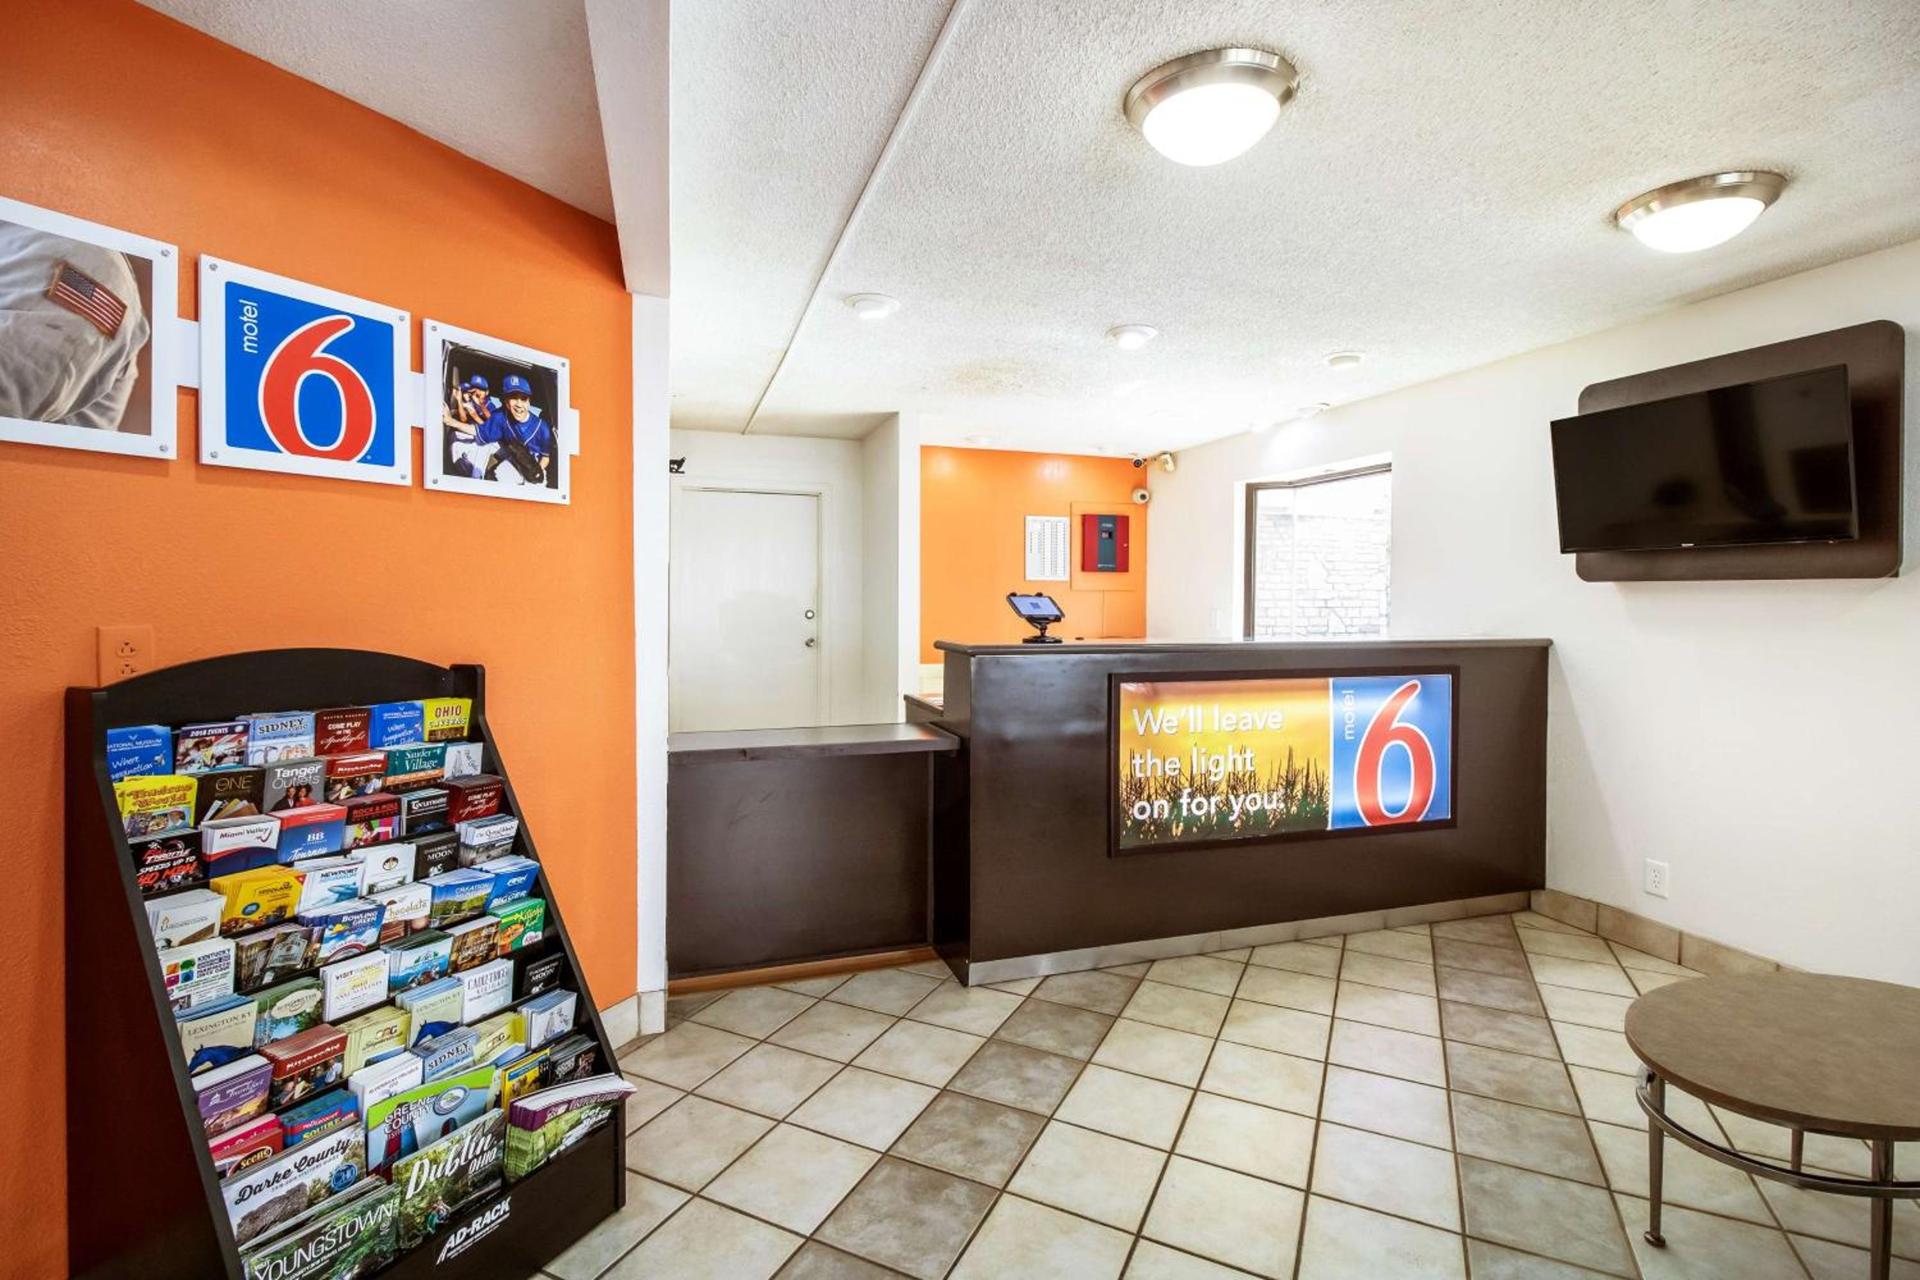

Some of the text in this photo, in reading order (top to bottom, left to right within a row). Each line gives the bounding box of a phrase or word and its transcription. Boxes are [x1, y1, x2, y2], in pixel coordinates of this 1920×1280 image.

[239, 299, 259, 354] motel
[257, 314, 377, 463] 6
[258, 718, 304, 735] SIDNEY
[435, 705, 462, 718] OHIO
[1132, 704, 1284, 736] We'll leave
[1343, 689, 1356, 741] motel
[405, 758, 438, 771] Village
[1131, 745, 1255, 782] the light
[1354, 679, 1437, 827] 6
[215, 776, 252, 792] ONE
[271, 772, 321, 790] Outlets
[274, 764, 322, 779] Tanger
[1133, 798, 1170, 821] on
[1181, 787, 1219, 817] for
[219, 827, 269, 840] Miami Valley
[187, 1015, 238, 1037] LEXINGTON
[428, 1040, 472, 1072] SIDNEY
[384, 1104, 435, 1135] COUNTY
[234, 1168, 292, 1205] Darke
[293, 1136, 352, 1175] County
[405, 1130, 495, 1201] Dublin
[468, 1147, 498, 1173] OHIO
[254, 1199, 395, 1280] YOUNGSTOWN
[436, 1196, 511, 1265] AD-RACK
